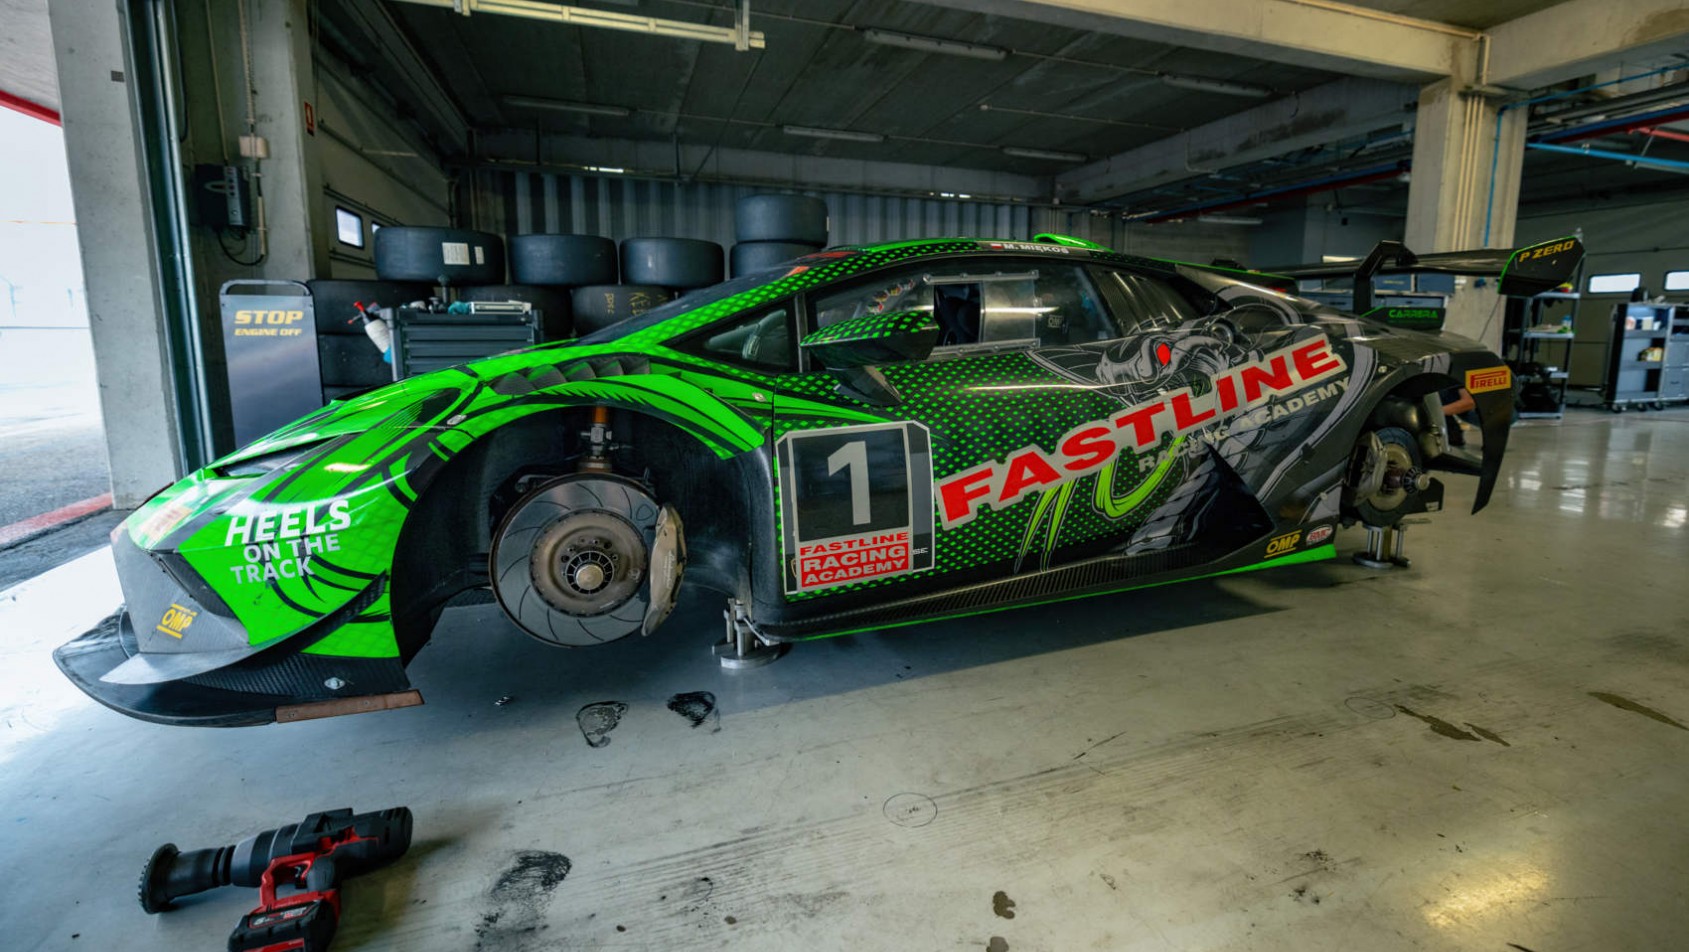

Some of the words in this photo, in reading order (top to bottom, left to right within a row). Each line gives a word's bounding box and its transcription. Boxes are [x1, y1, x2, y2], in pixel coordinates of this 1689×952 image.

[1519, 251, 1530, 262] P
[1532, 240, 1575, 259] ZERO
[234, 310, 304, 325] STOP
[1388, 309, 1438, 319] CARRERA
[234, 328, 278, 336] ENGINE
[280, 328, 302, 336] OFF
[1470, 370, 1507, 389] PIRELLI
[939, 339, 1341, 522] FASTLINE
[1138, 425, 1230, 472] RACING
[1239, 376, 1350, 429] ACADEMY
[828, 440, 871, 526] 1
[224, 499, 352, 547] HEELS
[243, 542, 281, 563] ON
[286, 533, 341, 558] THE
[800, 532, 909, 557] FASTLINE
[1266, 533, 1300, 554] OMP
[230, 556, 315, 585] TRACK
[804, 546, 906, 572] RACING
[804, 558, 906, 585] ACADEMY
[162, 608, 193, 632] OMP
